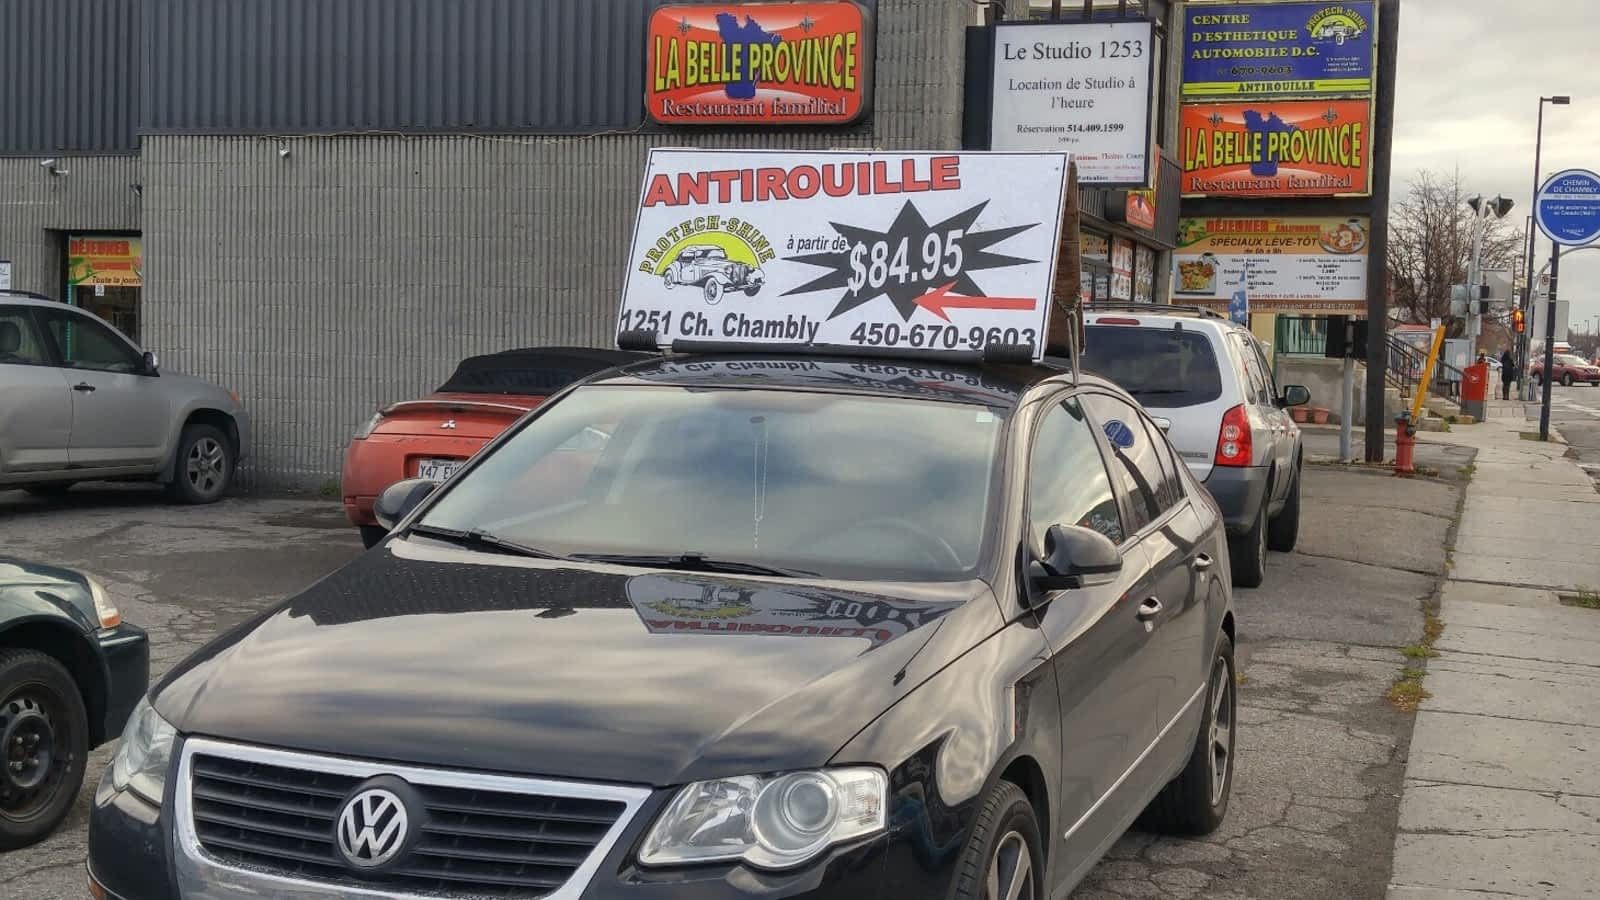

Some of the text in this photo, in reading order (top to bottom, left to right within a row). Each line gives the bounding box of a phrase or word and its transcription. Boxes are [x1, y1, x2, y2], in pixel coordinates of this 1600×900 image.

[1192, 14, 1250, 25] CENTRE
[1004, 40, 1143, 60] Le Studio 1253
[1192, 46, 1320, 60] AUTOMOBILE D.C.
[654, 31, 857, 92] LA BELLE PROVINCE
[1008, 76, 1136, 91] Location de Studio à
[1238, 81, 1316, 92] ANTIROUILLE
[661, 97, 847, 117] Restaurant familial
[1051, 96, 1094, 109] l'heure
[1017, 124, 1065, 134] Réservation
[1184, 122, 1362, 171] LA BELLE PROVINCE
[643, 156, 960, 207] ANTIROUILLE
[1191, 174, 1352, 192] Restaurant familial
[638, 214, 776, 274] PROTECH-SHINE
[787, 235, 847, 253] à partir de
[847, 229, 964, 296] $84.95
[621, 309, 820, 344] 1251 Ch. Chambly
[850, 321, 1036, 350] 450-670-9603
